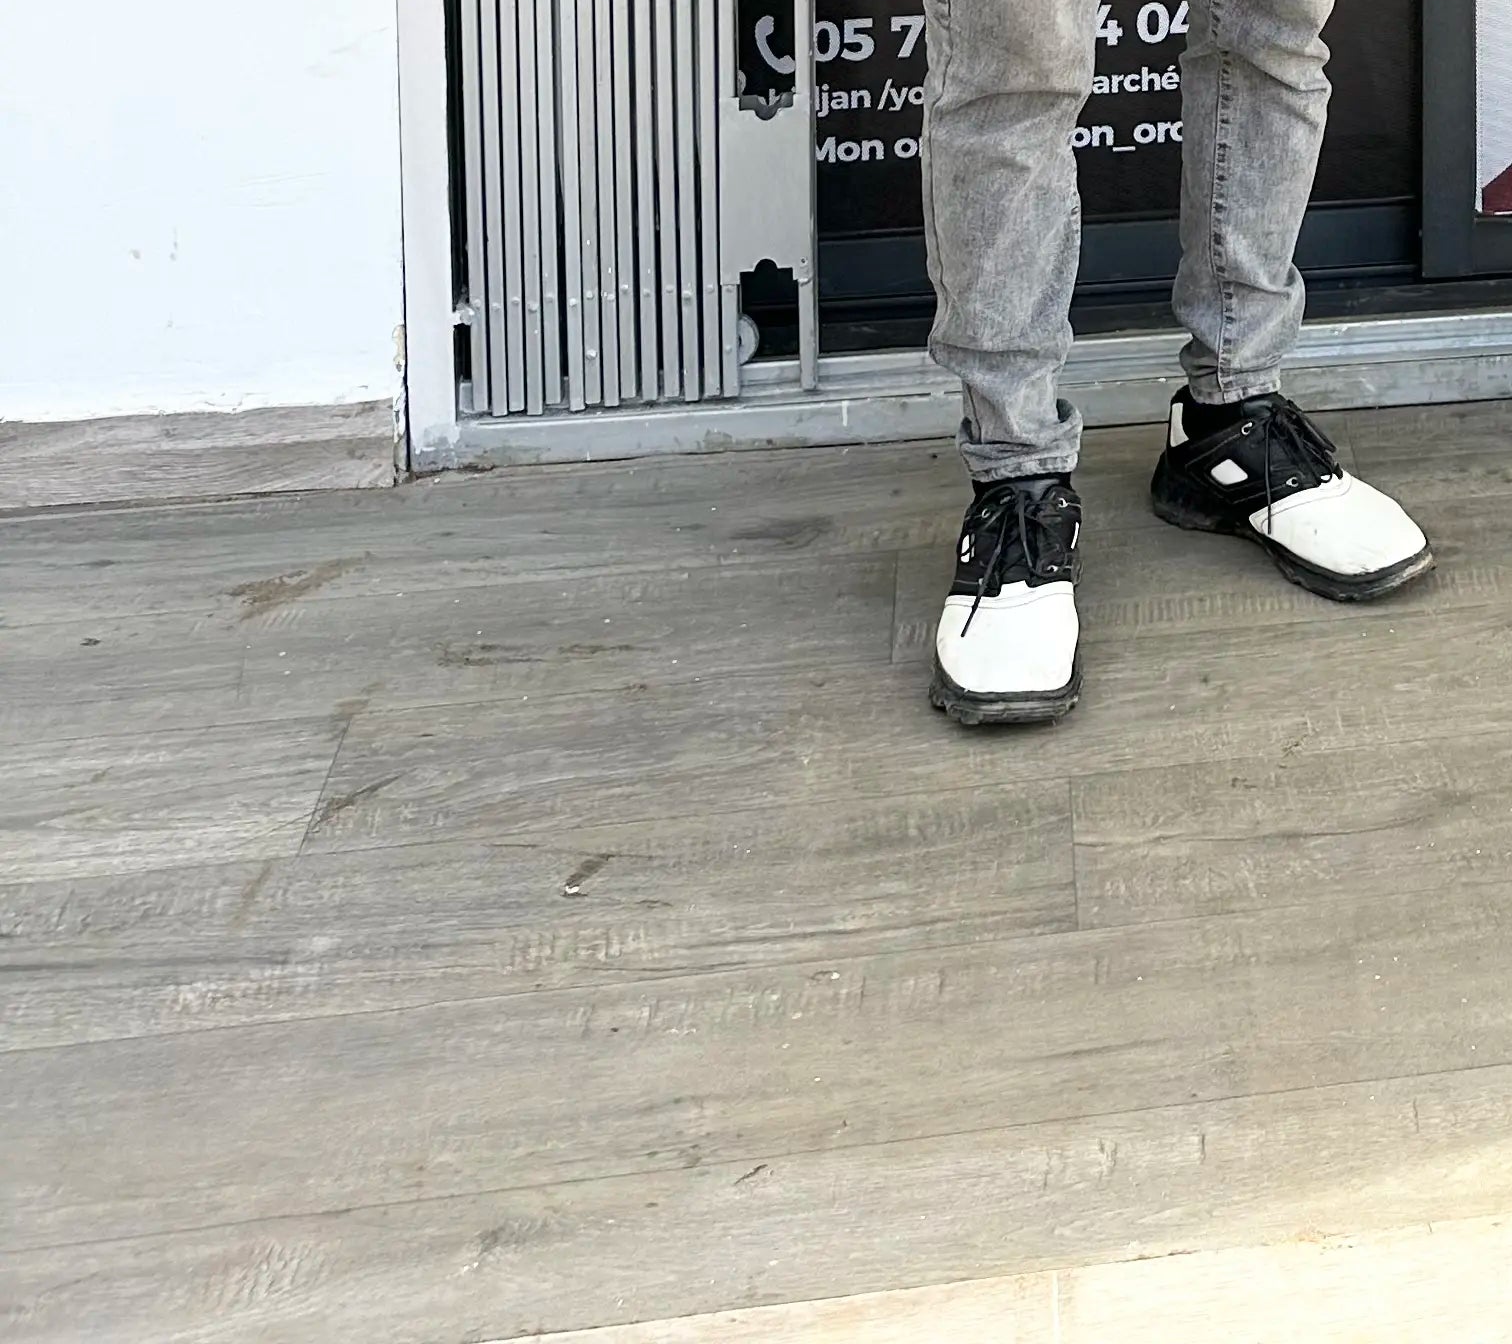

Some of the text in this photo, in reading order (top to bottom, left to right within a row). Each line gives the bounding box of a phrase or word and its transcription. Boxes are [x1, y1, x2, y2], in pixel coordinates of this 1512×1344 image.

[815, 16, 876, 62] 05
[890, 14, 926, 58] 7
[1097, 4, 1124, 46] 4
[1093, 64, 1181, 94] arché
